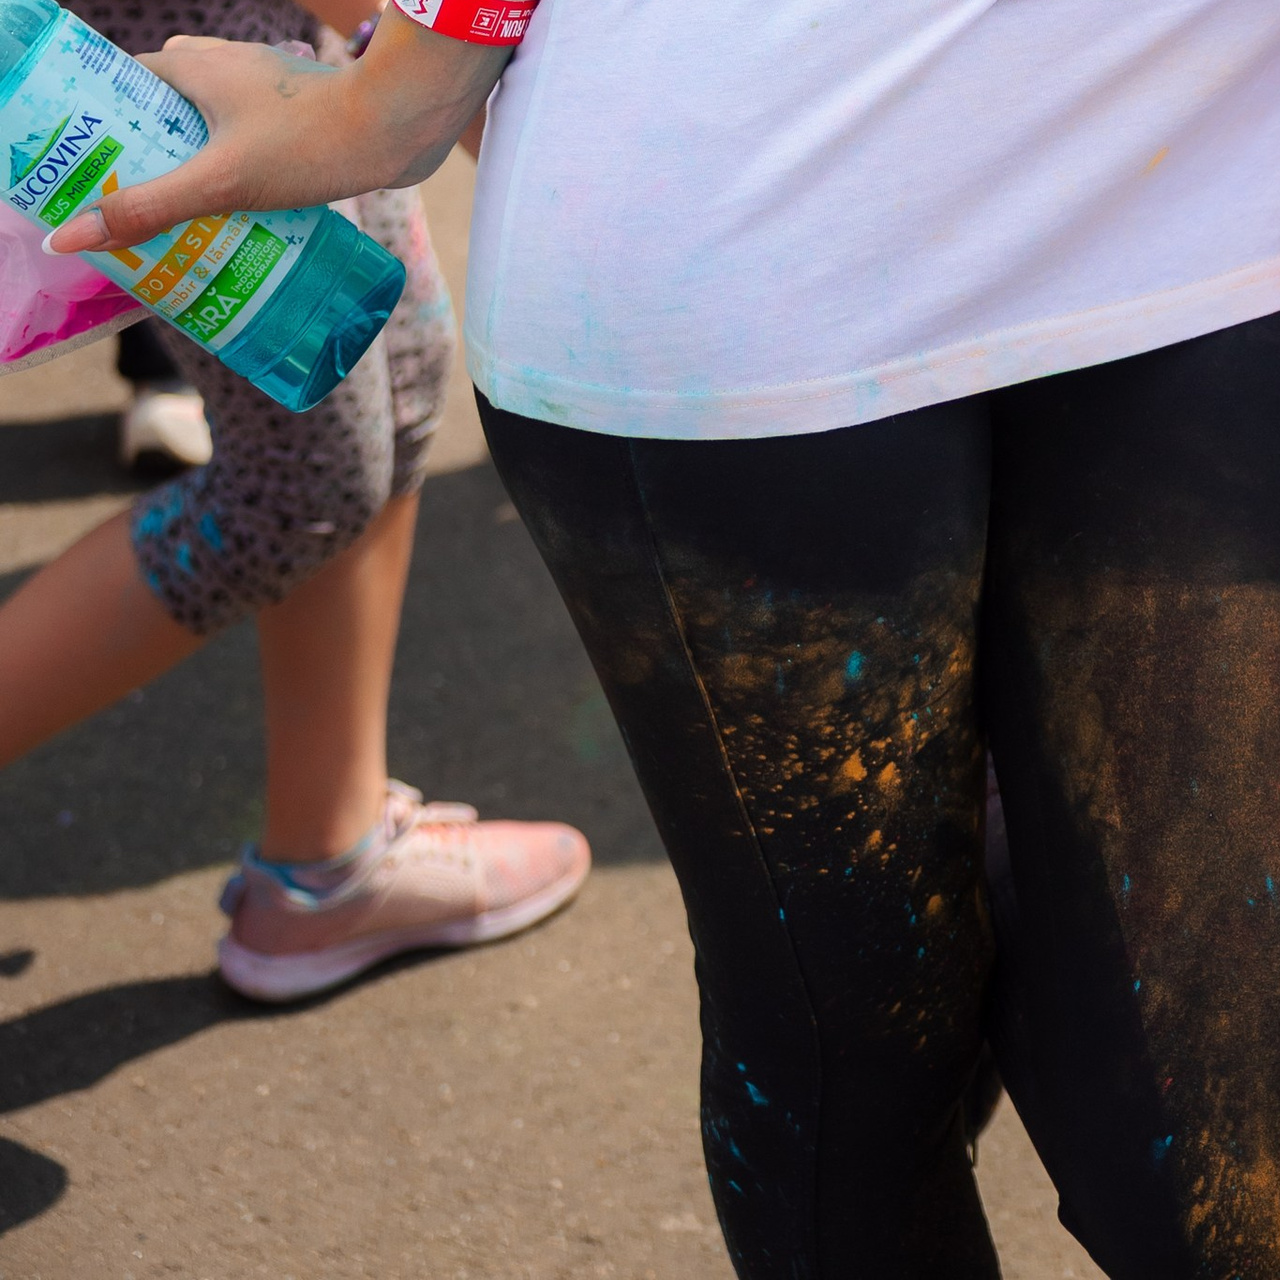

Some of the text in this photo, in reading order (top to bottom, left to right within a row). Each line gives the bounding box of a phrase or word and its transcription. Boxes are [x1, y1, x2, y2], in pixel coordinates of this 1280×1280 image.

[9, 112, 103, 211] BUCOVINA
[42, 144, 118, 223] PLUS MINERAL
[138, 212, 226, 300] POTASI
[193, 266, 211, 280] &
[228, 238, 255, 271] ZAHĂR
[234, 241, 264, 279] CALORII
[182, 286, 242, 339] FĂRĂ
